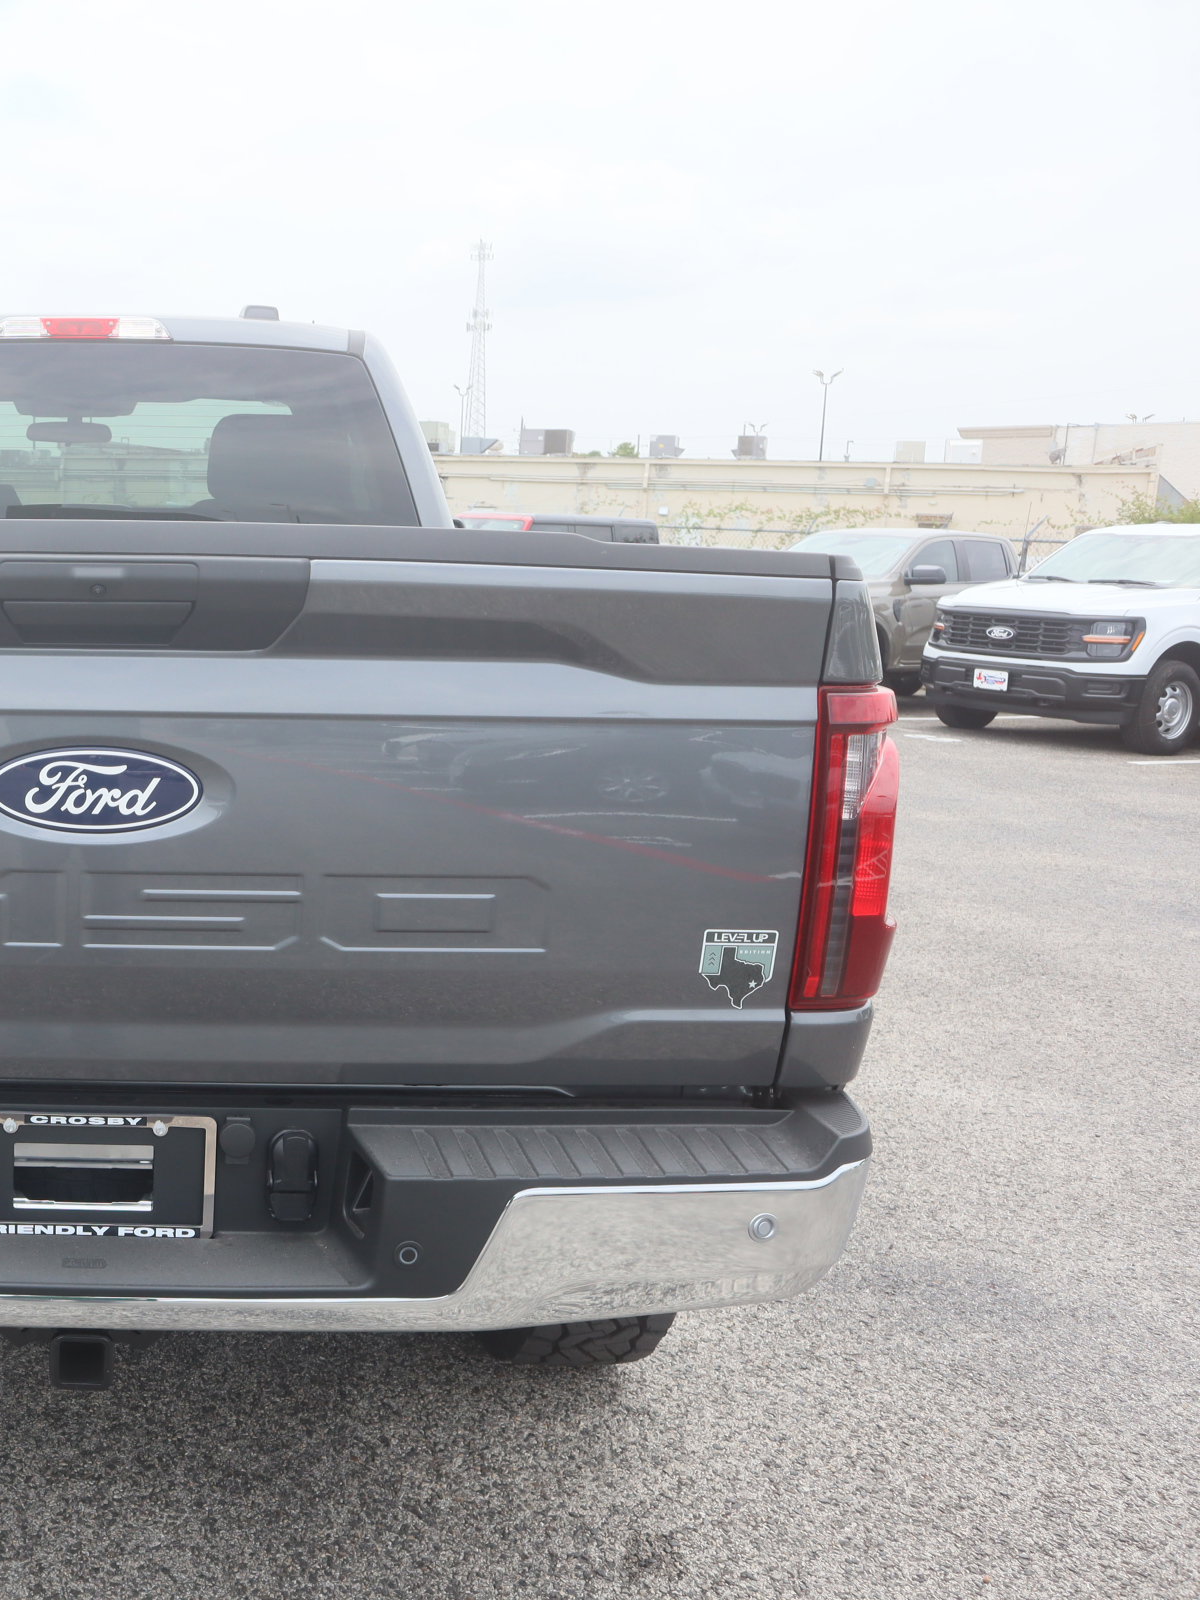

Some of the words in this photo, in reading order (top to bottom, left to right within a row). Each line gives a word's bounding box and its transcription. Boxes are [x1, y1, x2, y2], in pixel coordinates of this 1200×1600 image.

[25, 760, 161, 816] Ford
[713, 932, 751, 943] LEVEL
[752, 933, 769, 943] UP
[29, 1114, 143, 1127] CROSBY
[117, 1226, 196, 1239] FORD
